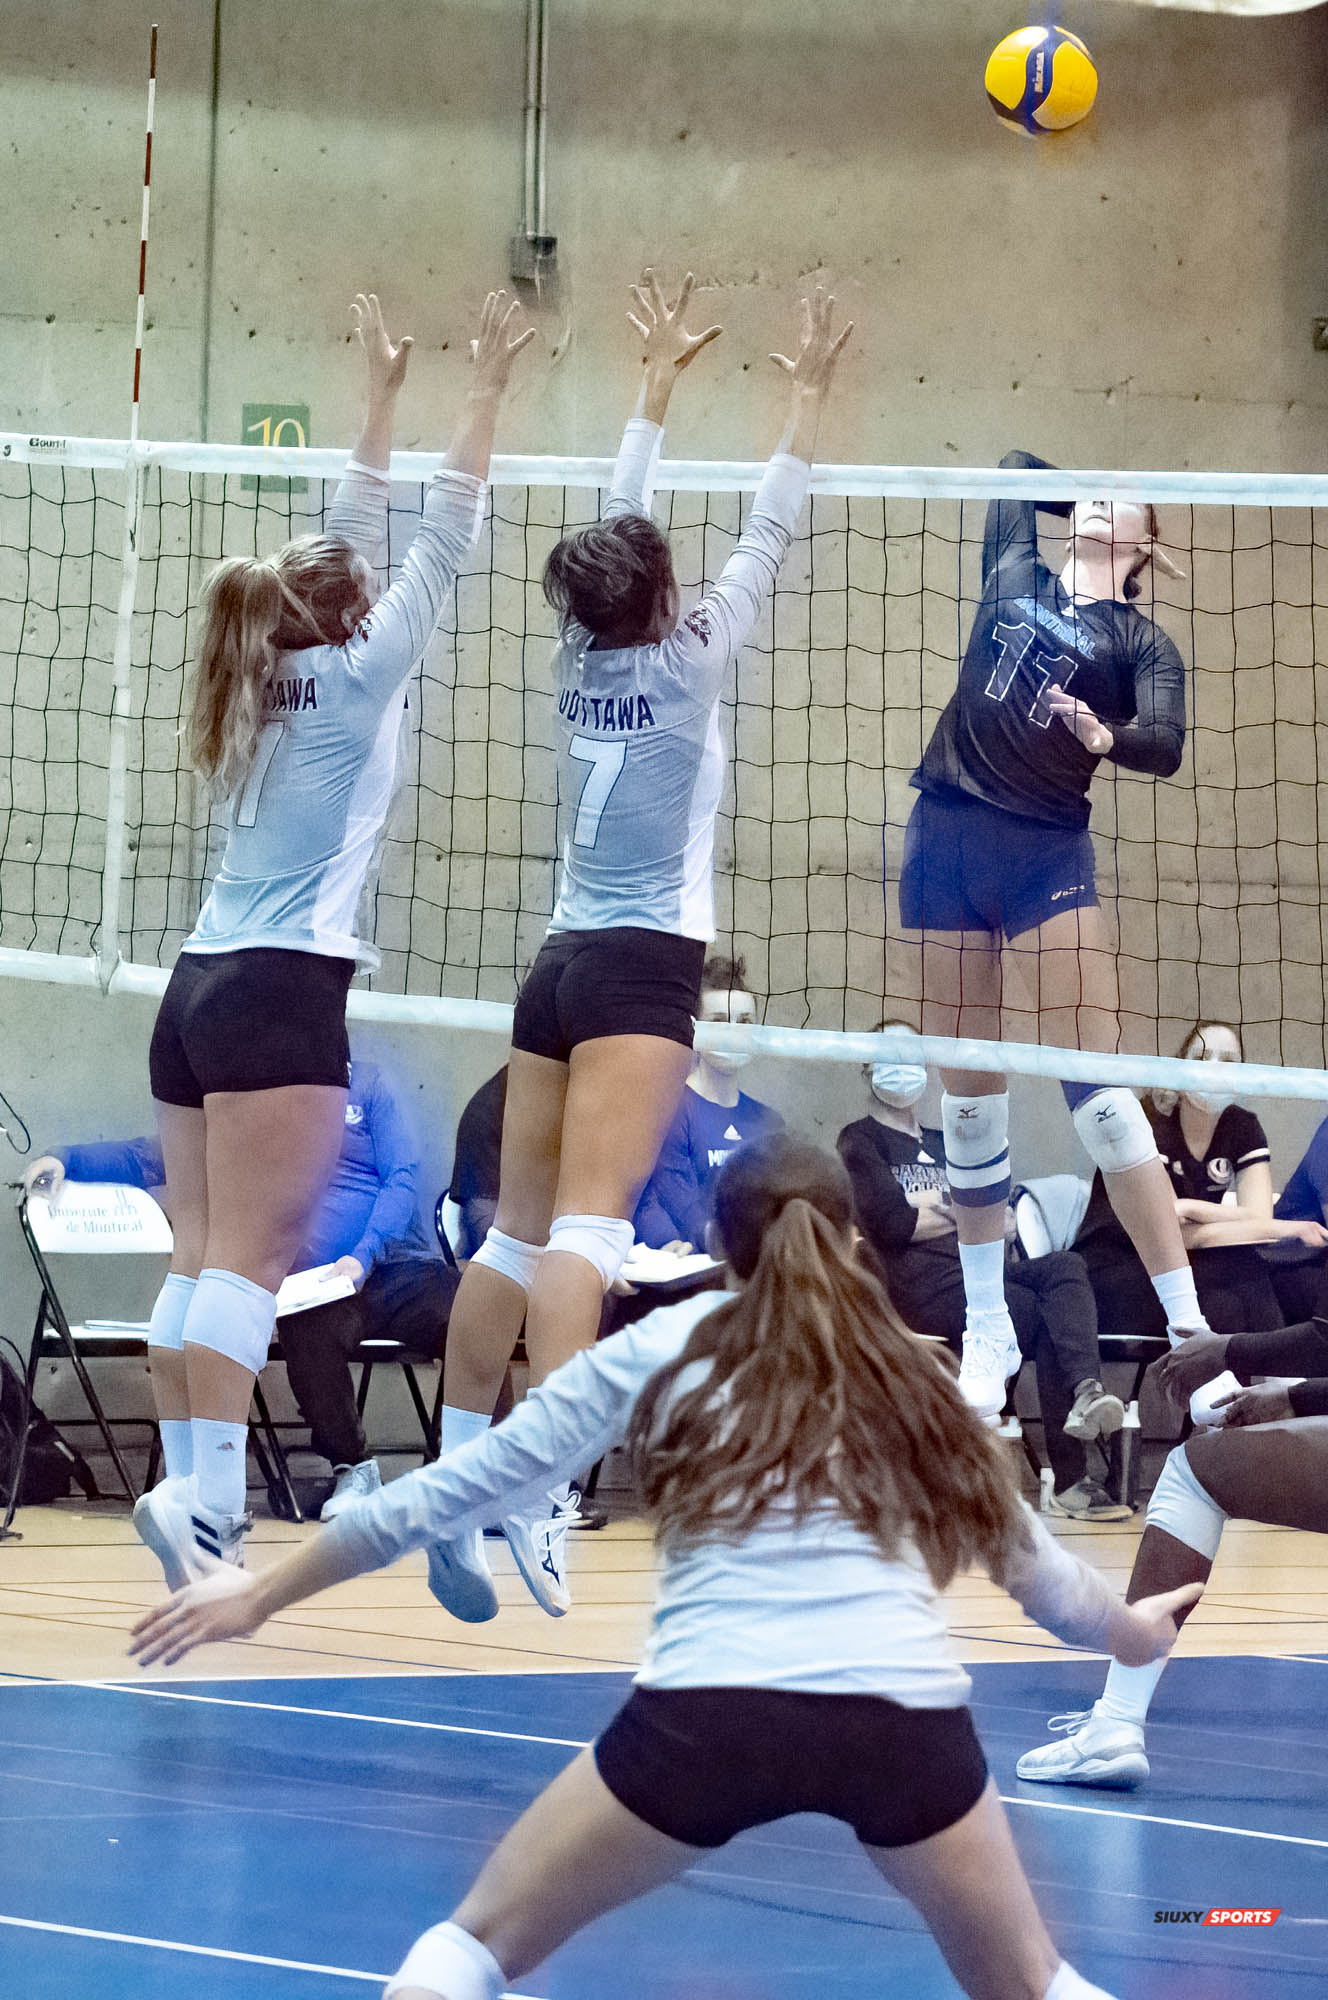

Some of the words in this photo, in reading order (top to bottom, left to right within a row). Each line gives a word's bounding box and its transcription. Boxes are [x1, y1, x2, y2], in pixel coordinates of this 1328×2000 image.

[559, 687, 656, 732] UOTTAWA
[984, 621, 1079, 729] 11
[568, 733, 628, 850] 7
